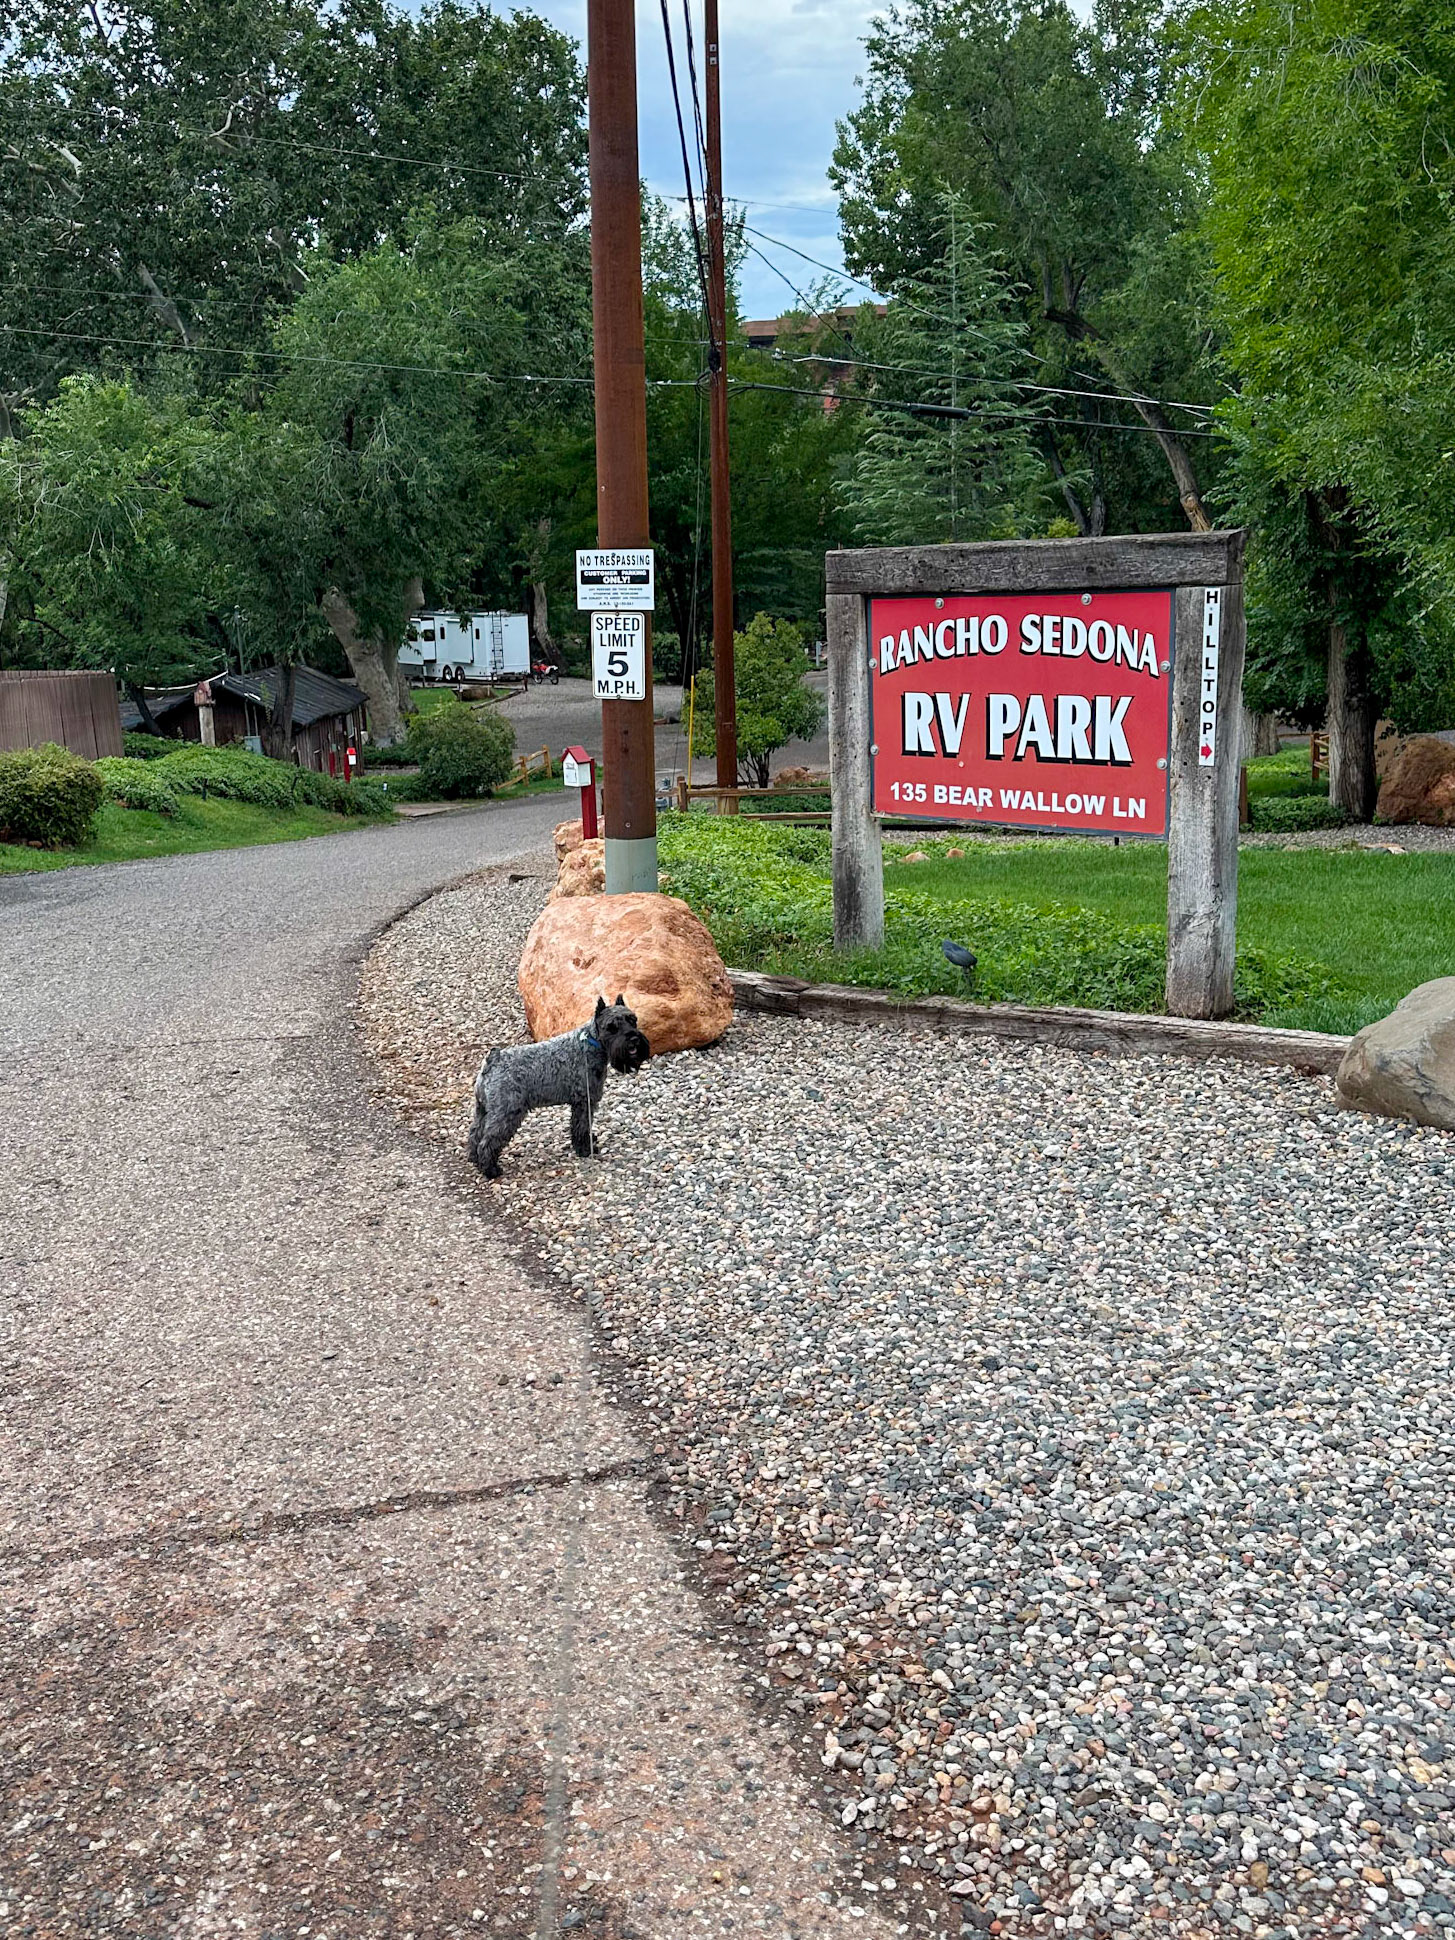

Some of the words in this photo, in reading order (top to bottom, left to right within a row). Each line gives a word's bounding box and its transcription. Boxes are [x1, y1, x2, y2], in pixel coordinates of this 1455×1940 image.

[580, 556, 591, 566] NO
[595, 555, 650, 566] TRESPASSING
[603, 576, 631, 584] ONLY!
[596, 617, 640, 632] SPEED
[600, 633, 636, 647] LIMIT
[879, 614, 1009, 676] RANCHO
[1019, 613, 1160, 679] SEDONA
[607, 651, 629, 677] 5
[1202, 590, 1219, 734] HILLTOP
[598, 680, 640, 695] M.P.H.
[901, 691, 971, 758] RV
[986, 693, 1136, 767] PARK
[890, 781, 927, 803] 135
[933, 784, 993, 808] BEAR
[1000, 788, 1107, 816] WALLOW
[1112, 796, 1146, 820] LN
